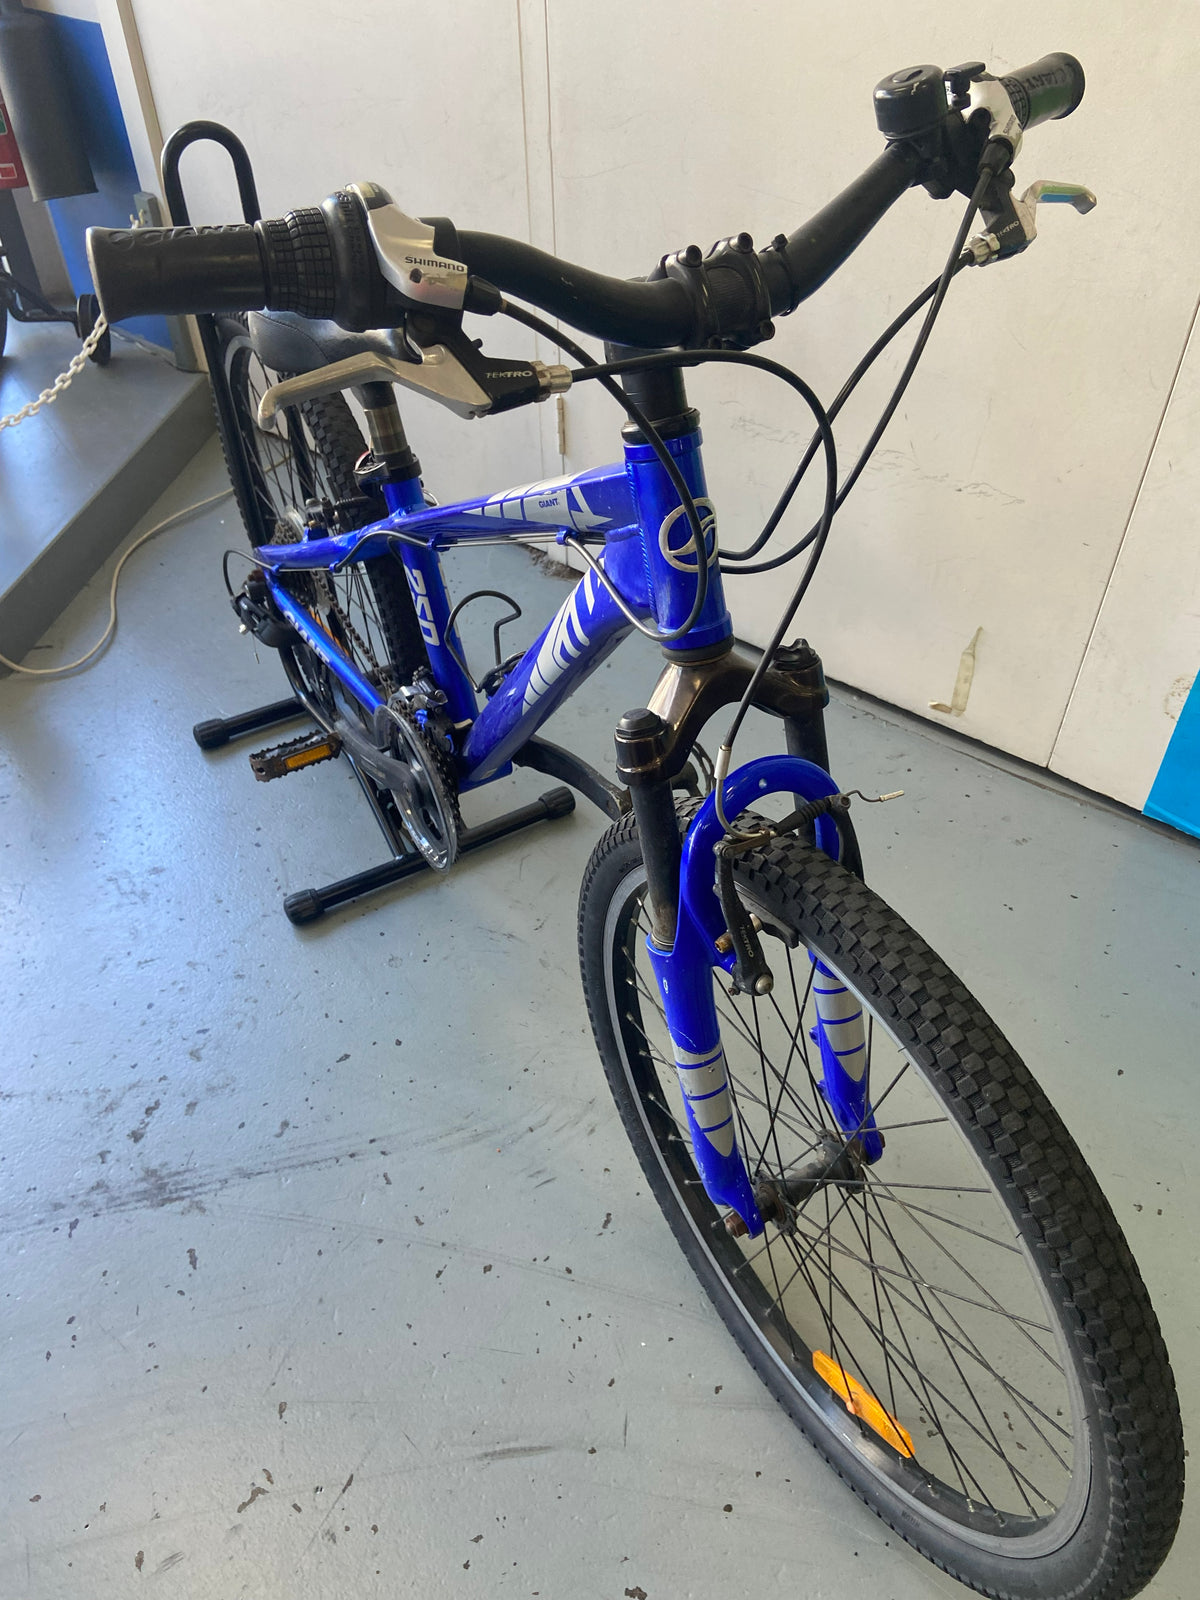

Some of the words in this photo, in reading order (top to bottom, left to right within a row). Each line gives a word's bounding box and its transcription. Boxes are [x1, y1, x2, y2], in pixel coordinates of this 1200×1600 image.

[405, 256, 465, 273] SHIMANO
[485, 370, 533, 379] TEKTRO
[538, 497, 559, 508] GIANT
